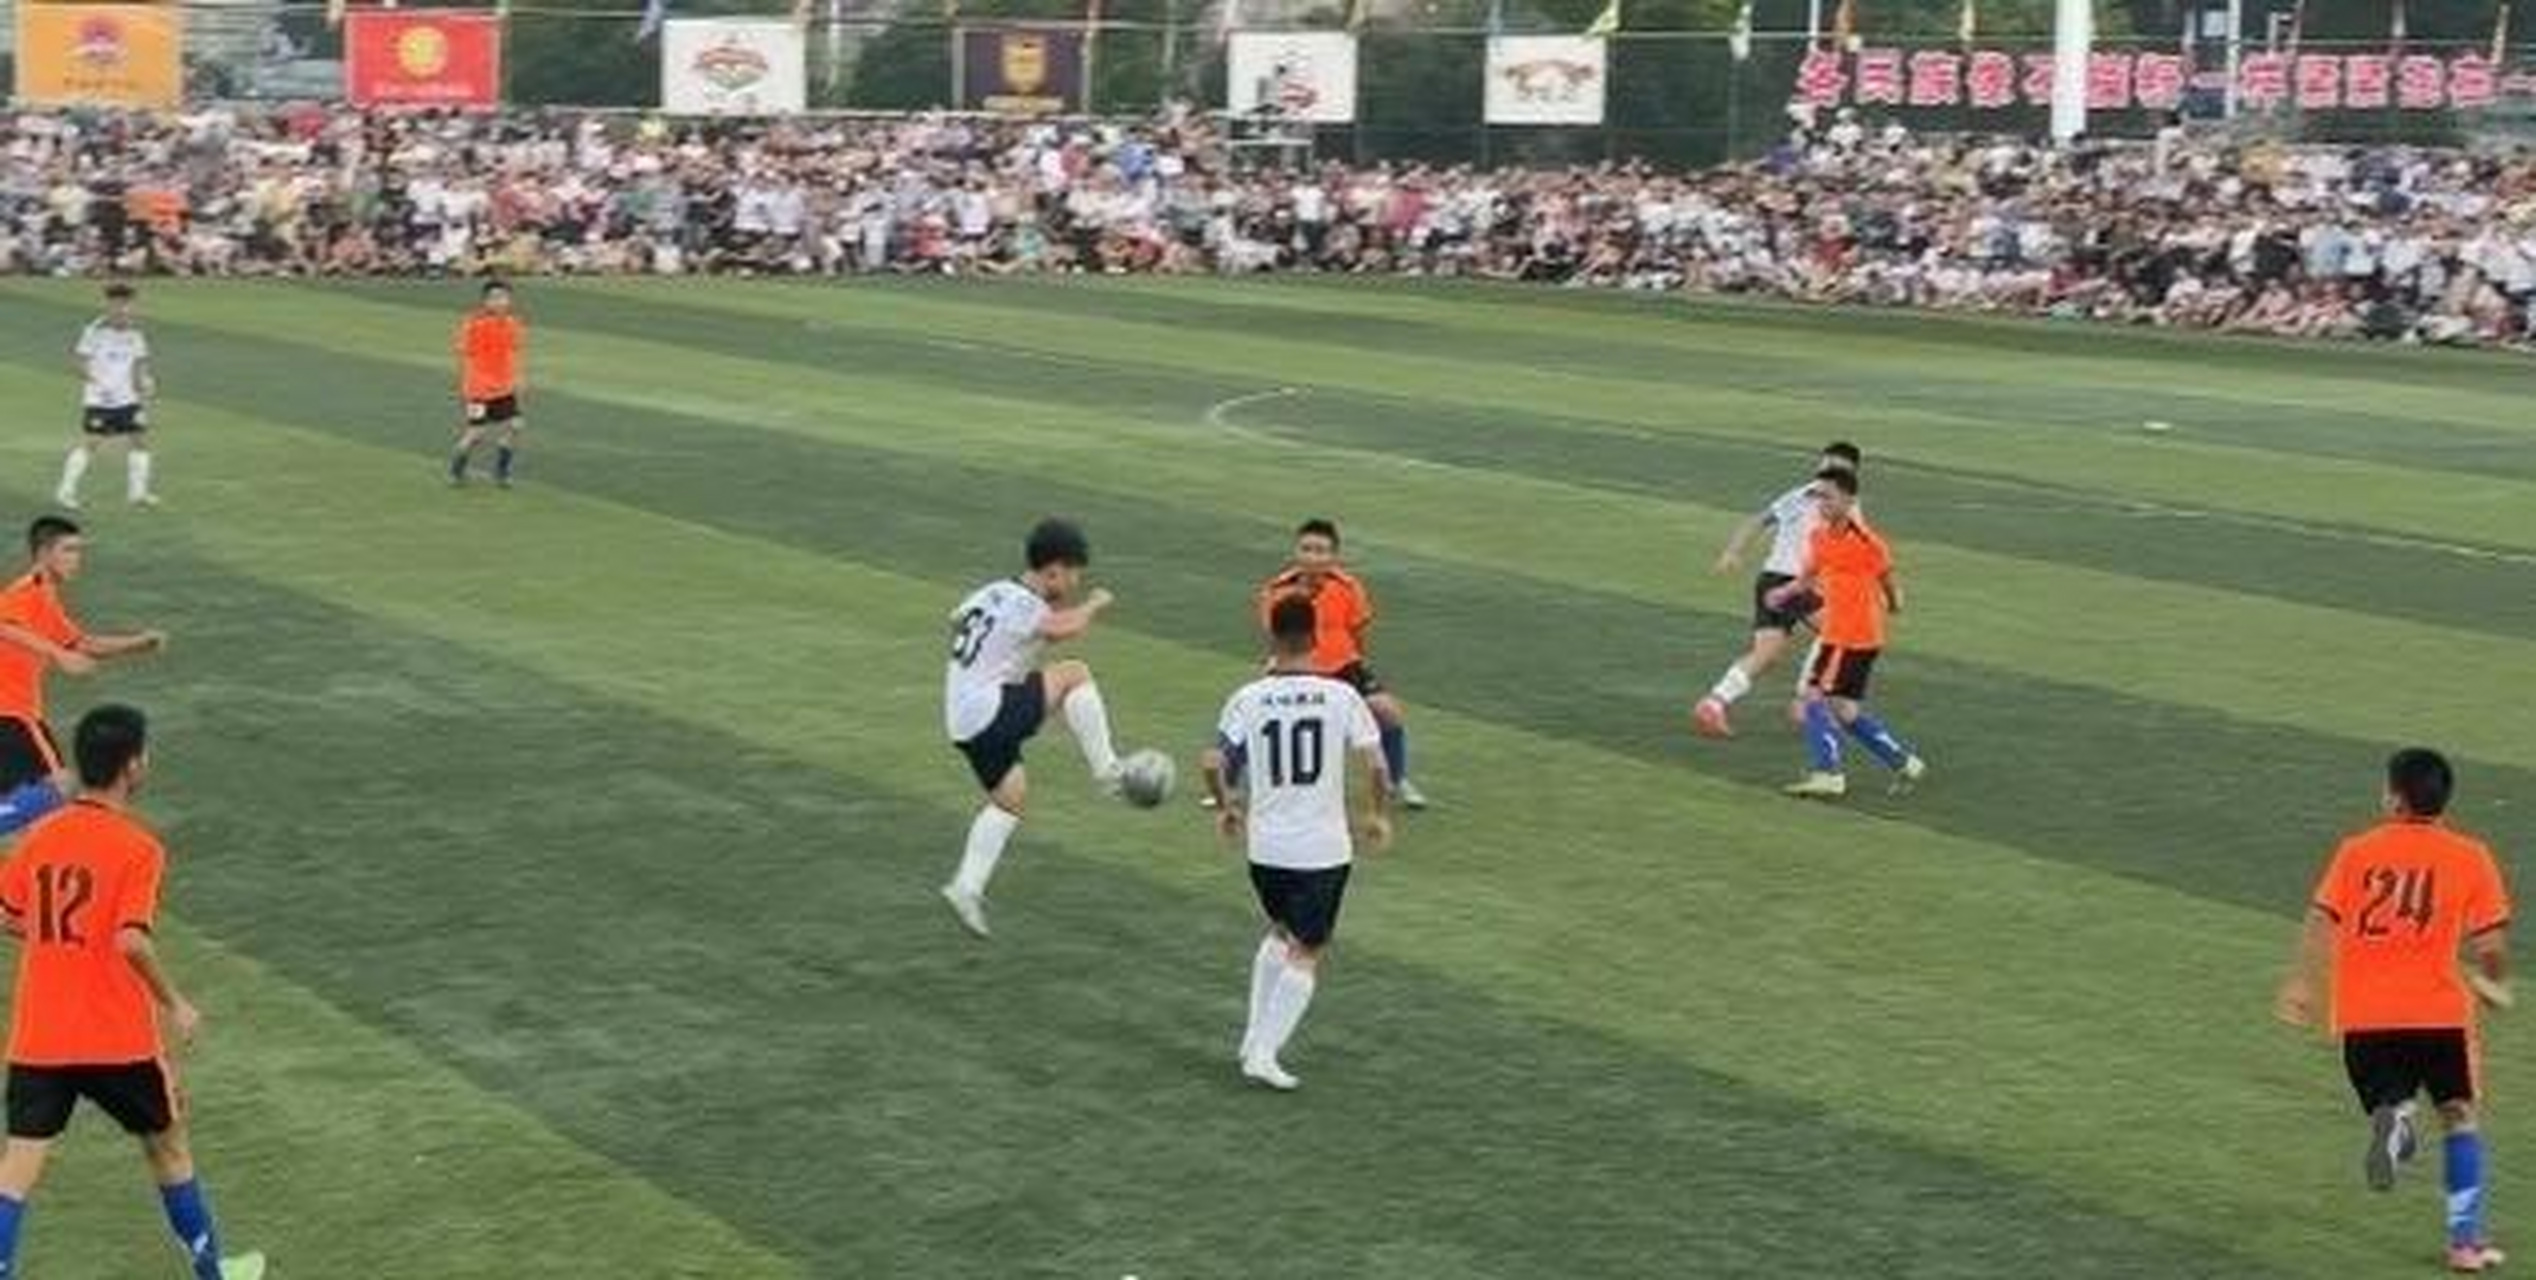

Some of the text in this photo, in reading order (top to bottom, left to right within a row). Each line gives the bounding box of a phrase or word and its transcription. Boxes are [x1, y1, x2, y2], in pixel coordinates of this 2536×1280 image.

[1261, 717, 1323, 787] 10
[36, 864, 92, 947] 12
[2357, 865, 2433, 935] 24
